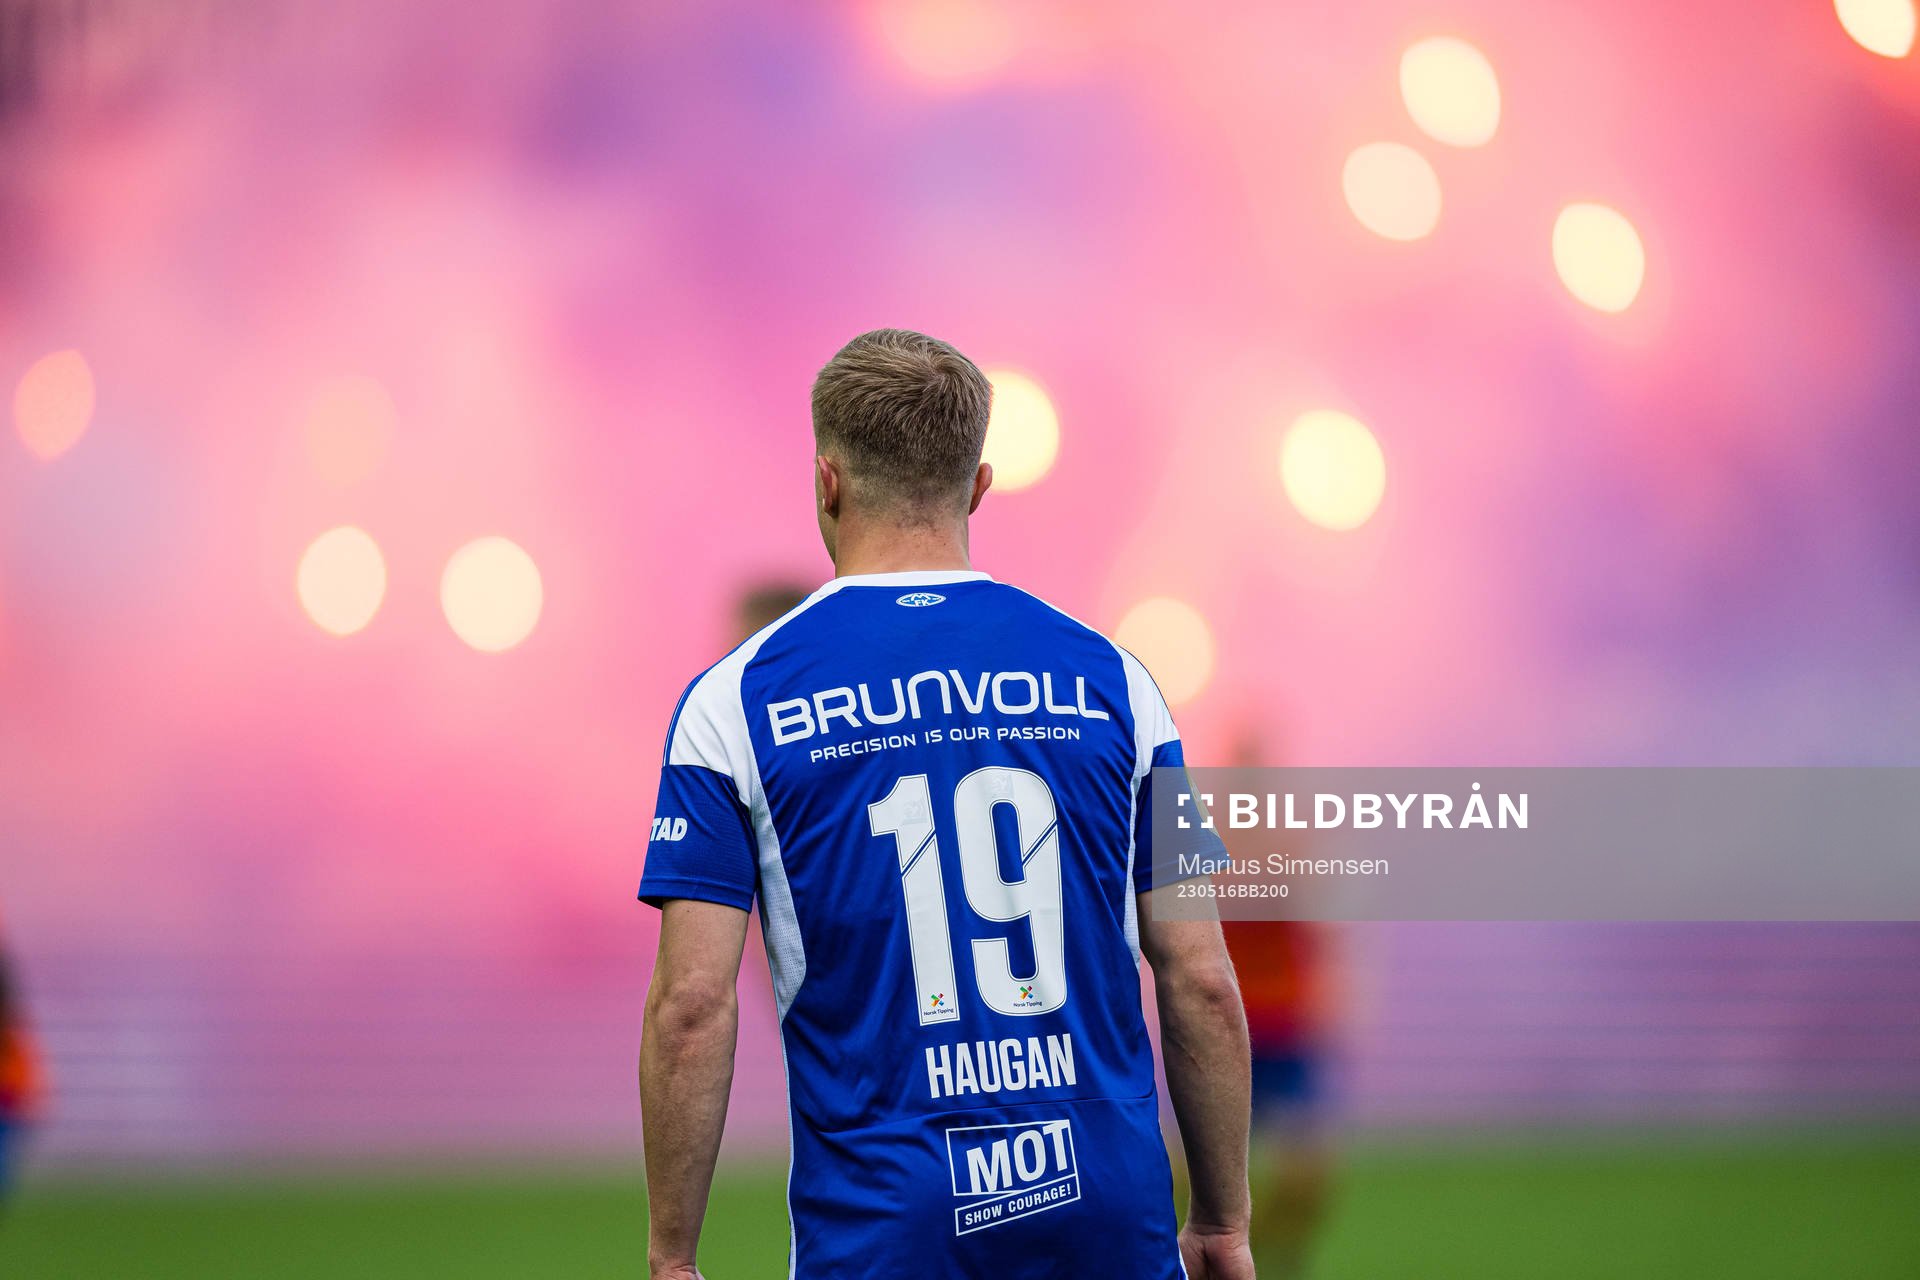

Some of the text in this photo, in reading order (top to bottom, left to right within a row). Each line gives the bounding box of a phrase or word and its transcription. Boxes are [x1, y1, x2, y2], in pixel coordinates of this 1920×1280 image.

[767, 670, 1109, 746] BRUNVOLL
[810, 727, 1080, 763] PRECISION IS OUR PASSION
[867, 766, 1067, 1026] 19
[925, 1033, 1077, 1099] HAUGAN
[966, 1120, 1070, 1193] MOT
[965, 1183, 1071, 1226] SHOW COURAGE!
